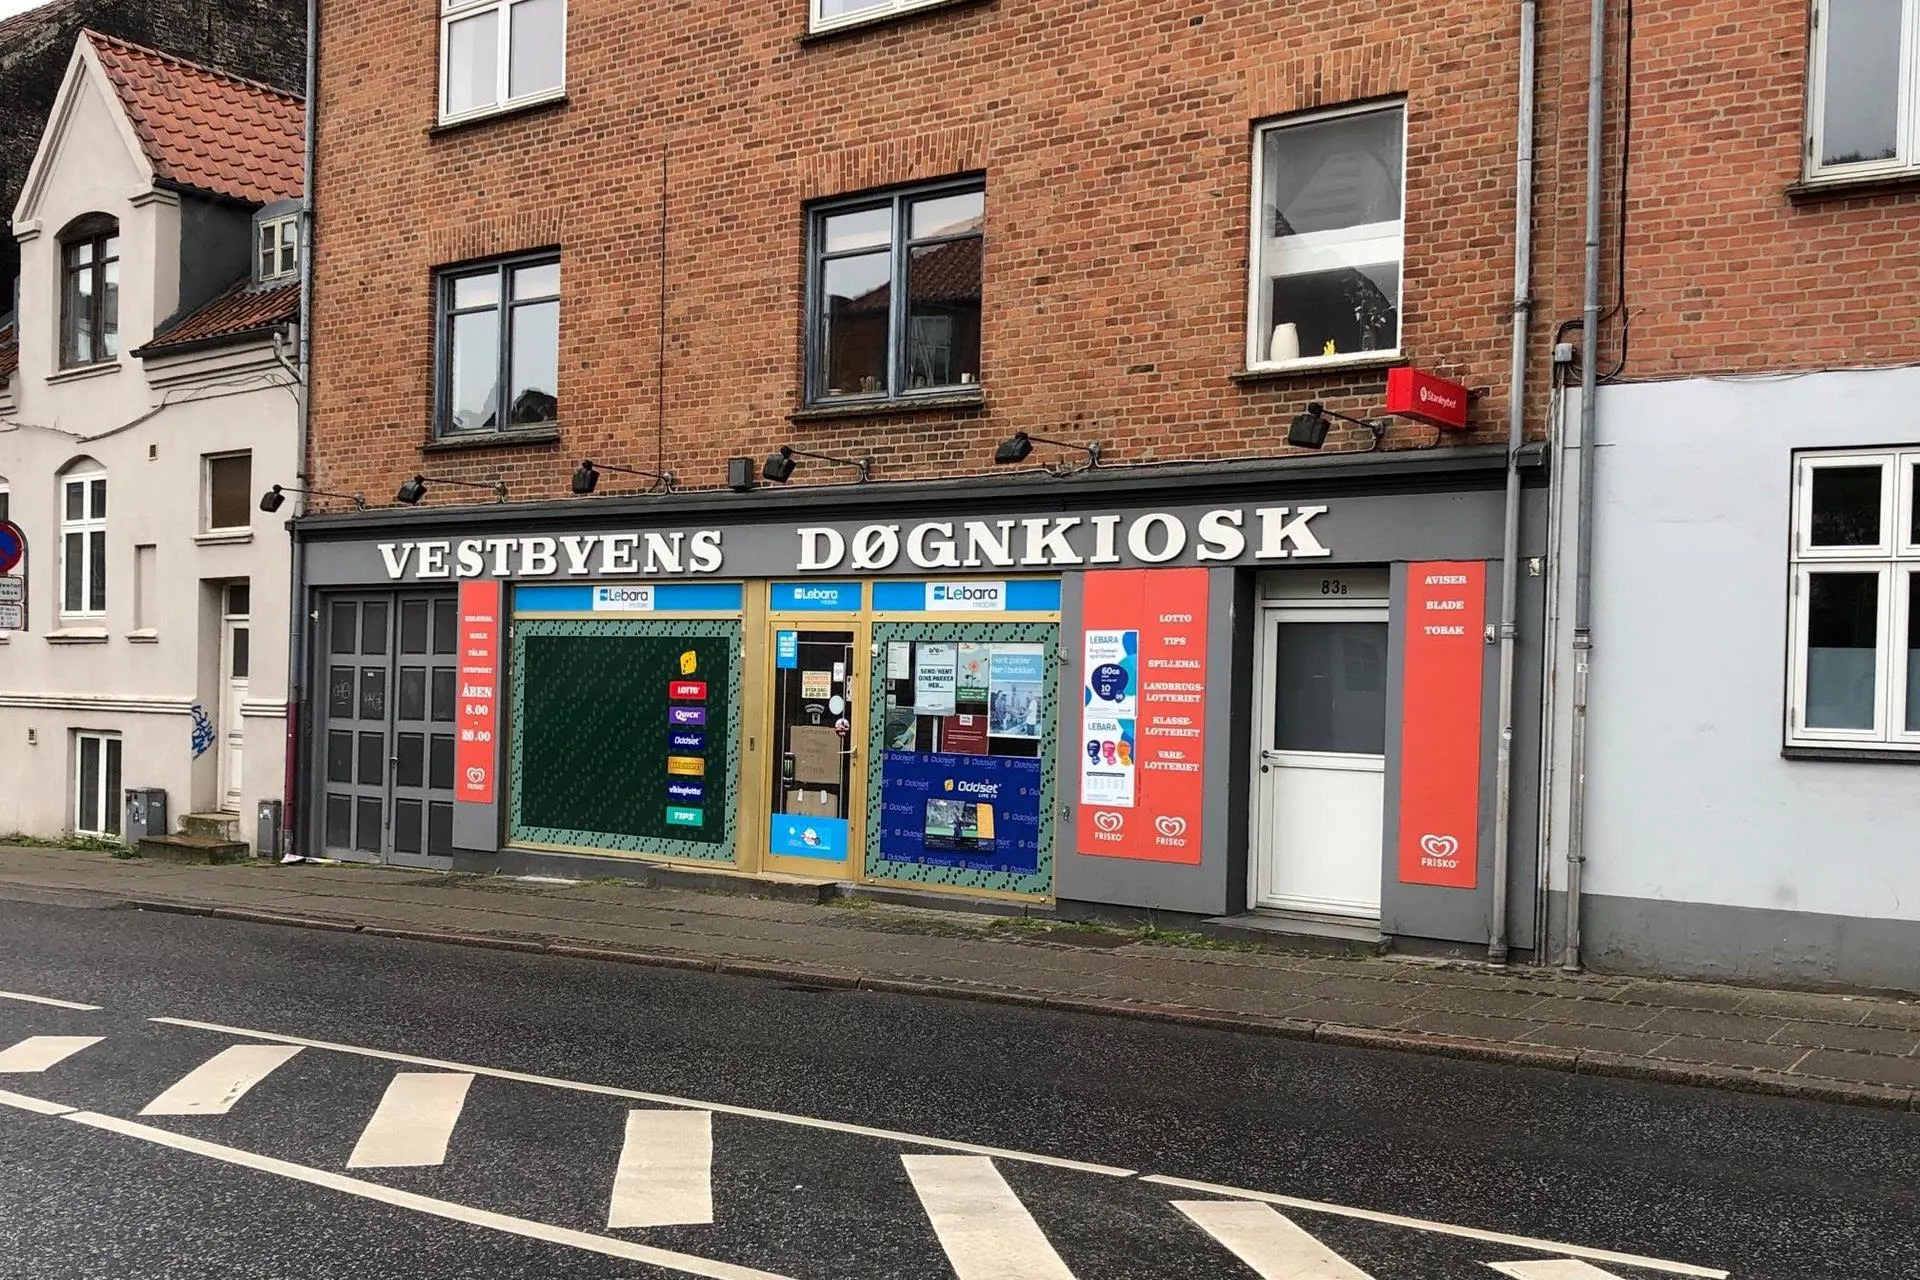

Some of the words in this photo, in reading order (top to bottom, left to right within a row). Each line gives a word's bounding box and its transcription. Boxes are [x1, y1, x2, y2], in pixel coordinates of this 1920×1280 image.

[1427, 390, 1456, 408] Stanleybet
[378, 530, 723, 579] VESTBYENS
[796, 505, 1331, 569] DØGNKIOSK
[1425, 575, 1467, 585] AVISER
[609, 589, 648, 601] Lebara
[802, 588, 838, 599] Lebara
[946, 586, 998, 600] Lebara
[1426, 601, 1465, 610] BLADE
[1160, 614, 1192, 623] LOTTO
[1424, 626, 1464, 635] TOBAK
[1089, 635, 1119, 644] LEBARA
[1164, 637, 1186, 645] TIPS
[1148, 660, 1201, 669] SPILLEHAL
[462, 682, 492, 698] ÅBEN
[677, 686, 699, 695] LOTTO
[1101, 684, 1111, 692] 10
[1144, 682, 1204, 691] LANDBRUGS-
[1146, 693, 1201, 703] LOTTERIET
[465, 704, 489, 715] 8.00
[1152, 716, 1193, 725] KLASSE-
[1088, 722, 1117, 731] LEBARA
[1145, 727, 1200, 738] LOTTERIET
[674, 736, 699, 745] Oddset
[1158, 750, 1185, 759] VARE-
[1144, 761, 1200, 772] LOTTERIET
[669, 785, 702, 796] vikinglotto
[958, 781, 998, 794] Oddset
[674, 811, 695, 820] TIPS
[1094, 831, 1122, 841] FRISKO
[1155, 836, 1185, 847] FRISKO
[1421, 857, 1458, 869] FRISKO
